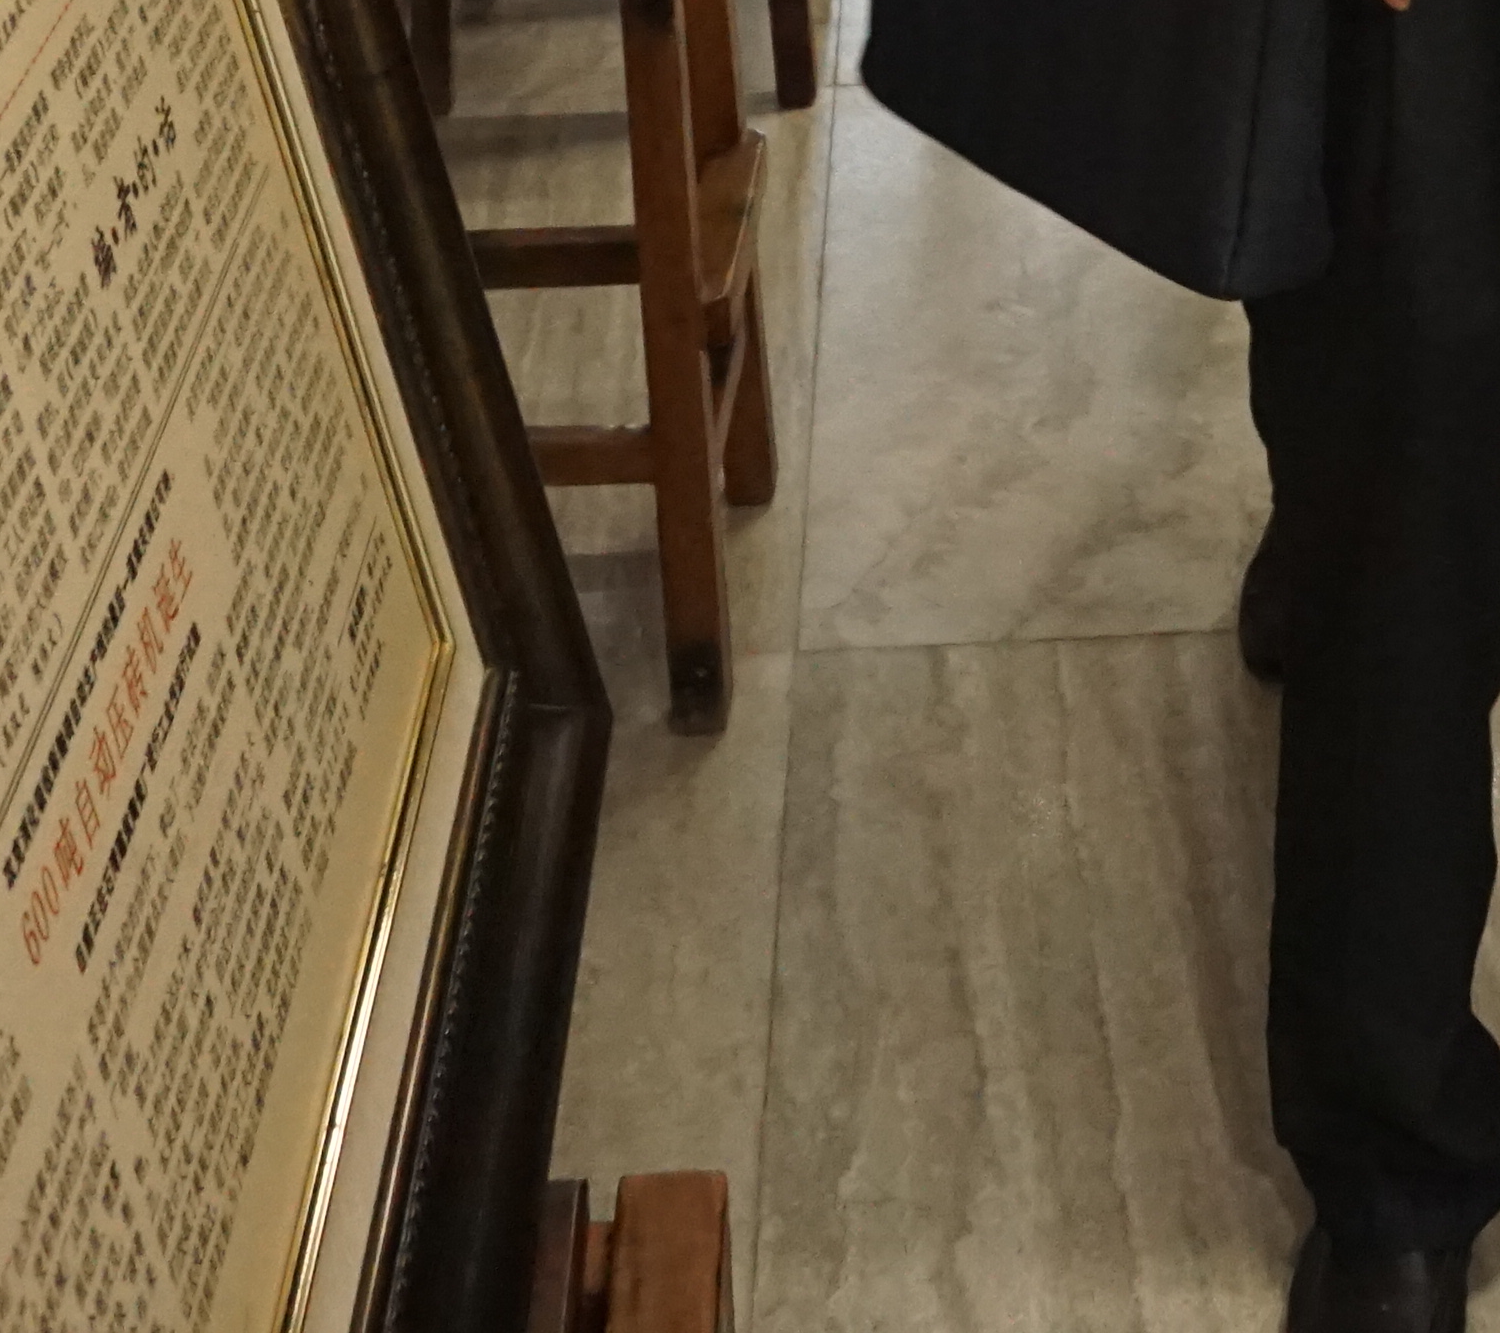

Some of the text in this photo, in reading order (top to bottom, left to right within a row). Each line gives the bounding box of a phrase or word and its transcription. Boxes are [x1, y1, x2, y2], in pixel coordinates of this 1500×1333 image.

[20, 538, 196, 968] 600吨自动压砖机诞生
